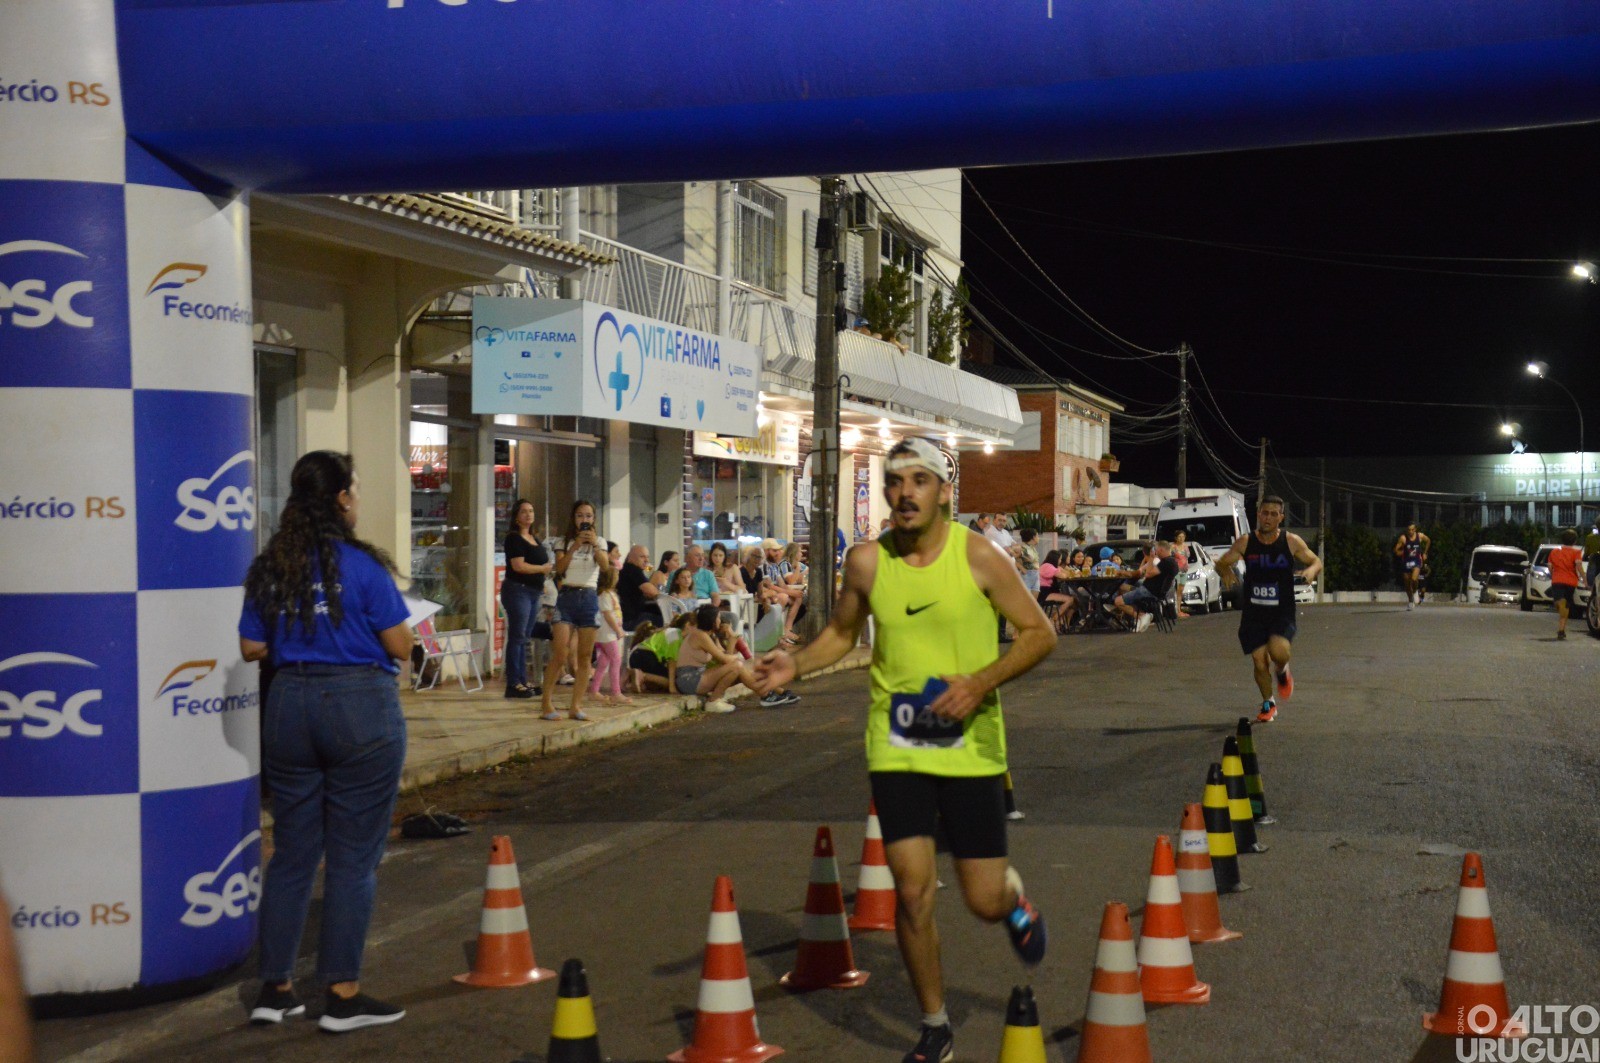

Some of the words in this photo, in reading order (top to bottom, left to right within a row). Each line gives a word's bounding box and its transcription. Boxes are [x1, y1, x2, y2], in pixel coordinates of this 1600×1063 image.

[68, 80, 111, 107] RS
[506, 330, 577, 343] VITAFARMA
[641, 322, 721, 372] VITAFARMA
[1515, 479, 1572, 497] PADRE
[85, 496, 126, 519] RS
[1248, 553, 1289, 568] FILA
[1253, 586, 1277, 597] 083
[90, 901, 131, 926] RS
